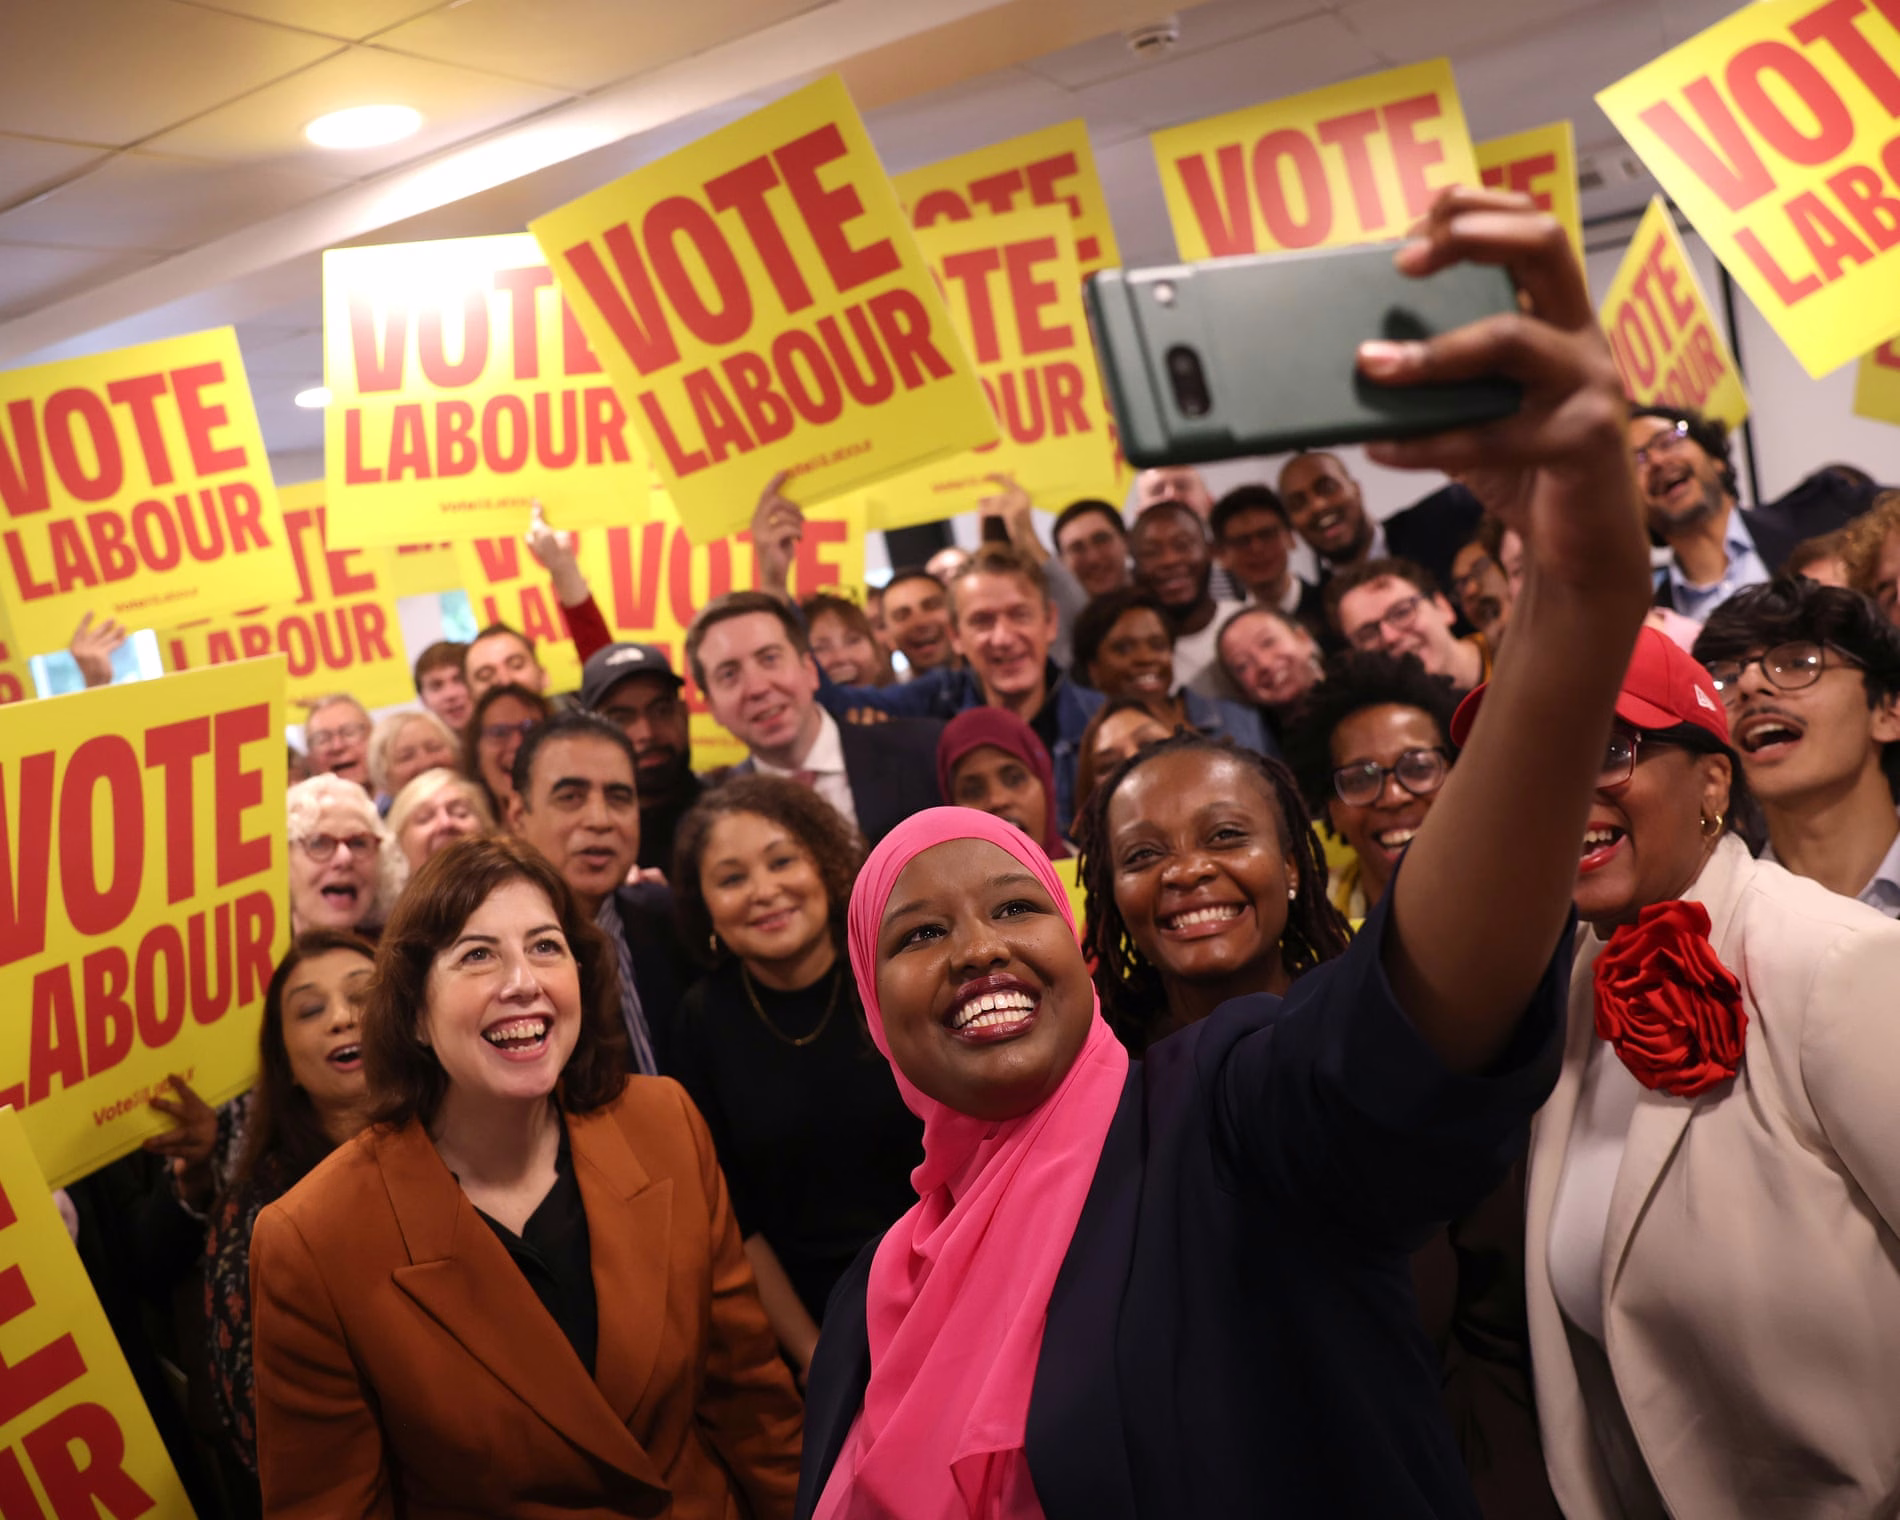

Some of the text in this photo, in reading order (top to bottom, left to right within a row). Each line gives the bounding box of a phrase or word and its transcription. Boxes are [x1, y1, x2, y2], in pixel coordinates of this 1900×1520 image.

[1174, 92, 1448, 258] VOTE
[1637, 0, 1900, 214] VOT
[562, 121, 902, 377] VOTE
[942, 234, 1075, 365] TE
[1732, 132, 1900, 308] LAB
[0, 361, 249, 517] VOTE
[345, 386, 631, 486] LABOUR
[637, 288, 955, 479] LABOUR
[3, 481, 272, 601] LABOUR
[0, 702, 272, 967] VOTE
